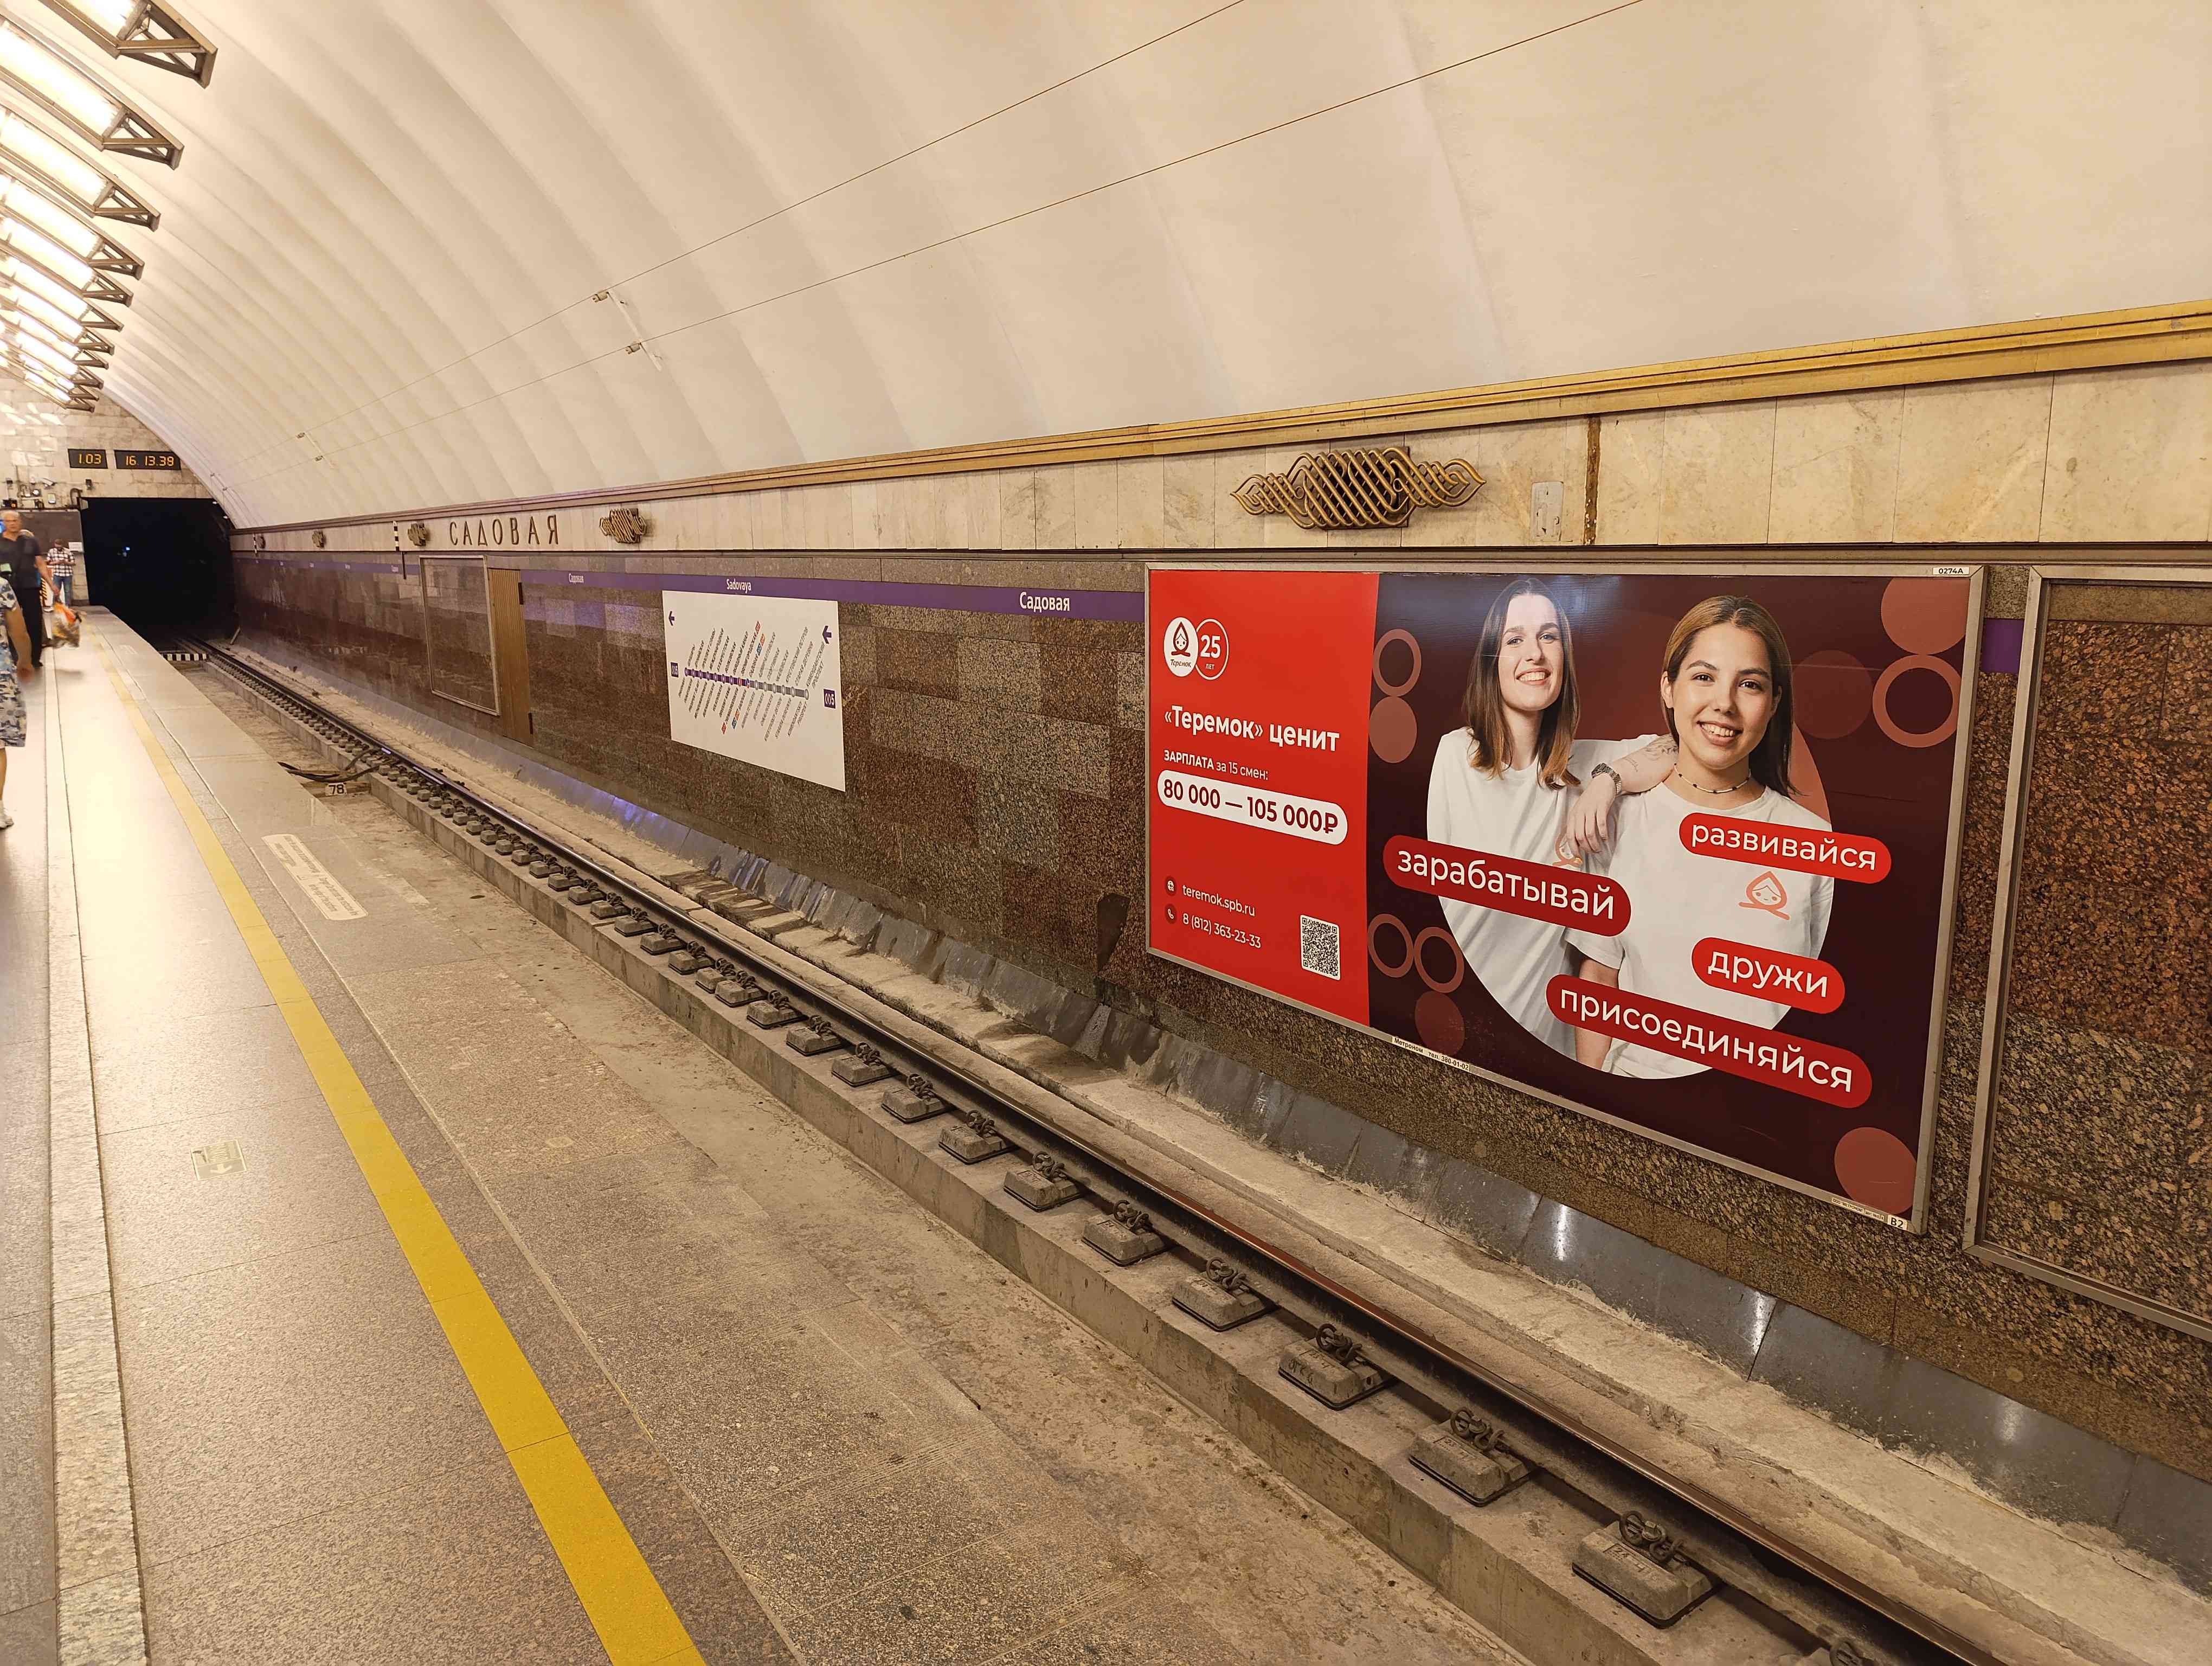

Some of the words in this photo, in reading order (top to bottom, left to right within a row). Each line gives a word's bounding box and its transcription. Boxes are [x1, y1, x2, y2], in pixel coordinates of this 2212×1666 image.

[449, 514, 558, 546] САДОВАЯ
[726, 578, 751, 594] Sadovaya
[1020, 591, 1070, 613] Садовая
[1200, 635, 1221, 658] 25
[1165, 705, 1263, 739] «Теремок»
[1269, 723, 1340, 752] ценит
[1164, 749, 1214, 770] ЗАРПЛАТА
[1216, 761, 1226, 772] за
[1229, 761, 1238, 774] 15
[1240, 765, 1268, 780] смен:
[329, 784, 344, 794] 78
[1163, 779, 1183, 800] 80
[1188, 784, 1220, 809] 000
[1247, 797, 1277, 822] 105
[1692, 824, 1876, 870] развивайся
[1182, 885, 1255, 917] teremok.spb.ru
[1398, 850, 1614, 920] зарабатывай
[1182, 913, 1189, 925] 8
[1191, 915, 1212, 935] (812)
[1214, 922, 1261, 948] 363-23-33
[1708, 951, 1828, 997] дружи
[1394, 1037, 1423, 1053] Метроном
[1441, 1055, 1469, 1071] 380-01-02
[1560, 989, 1853, 1093] присоединяйся
